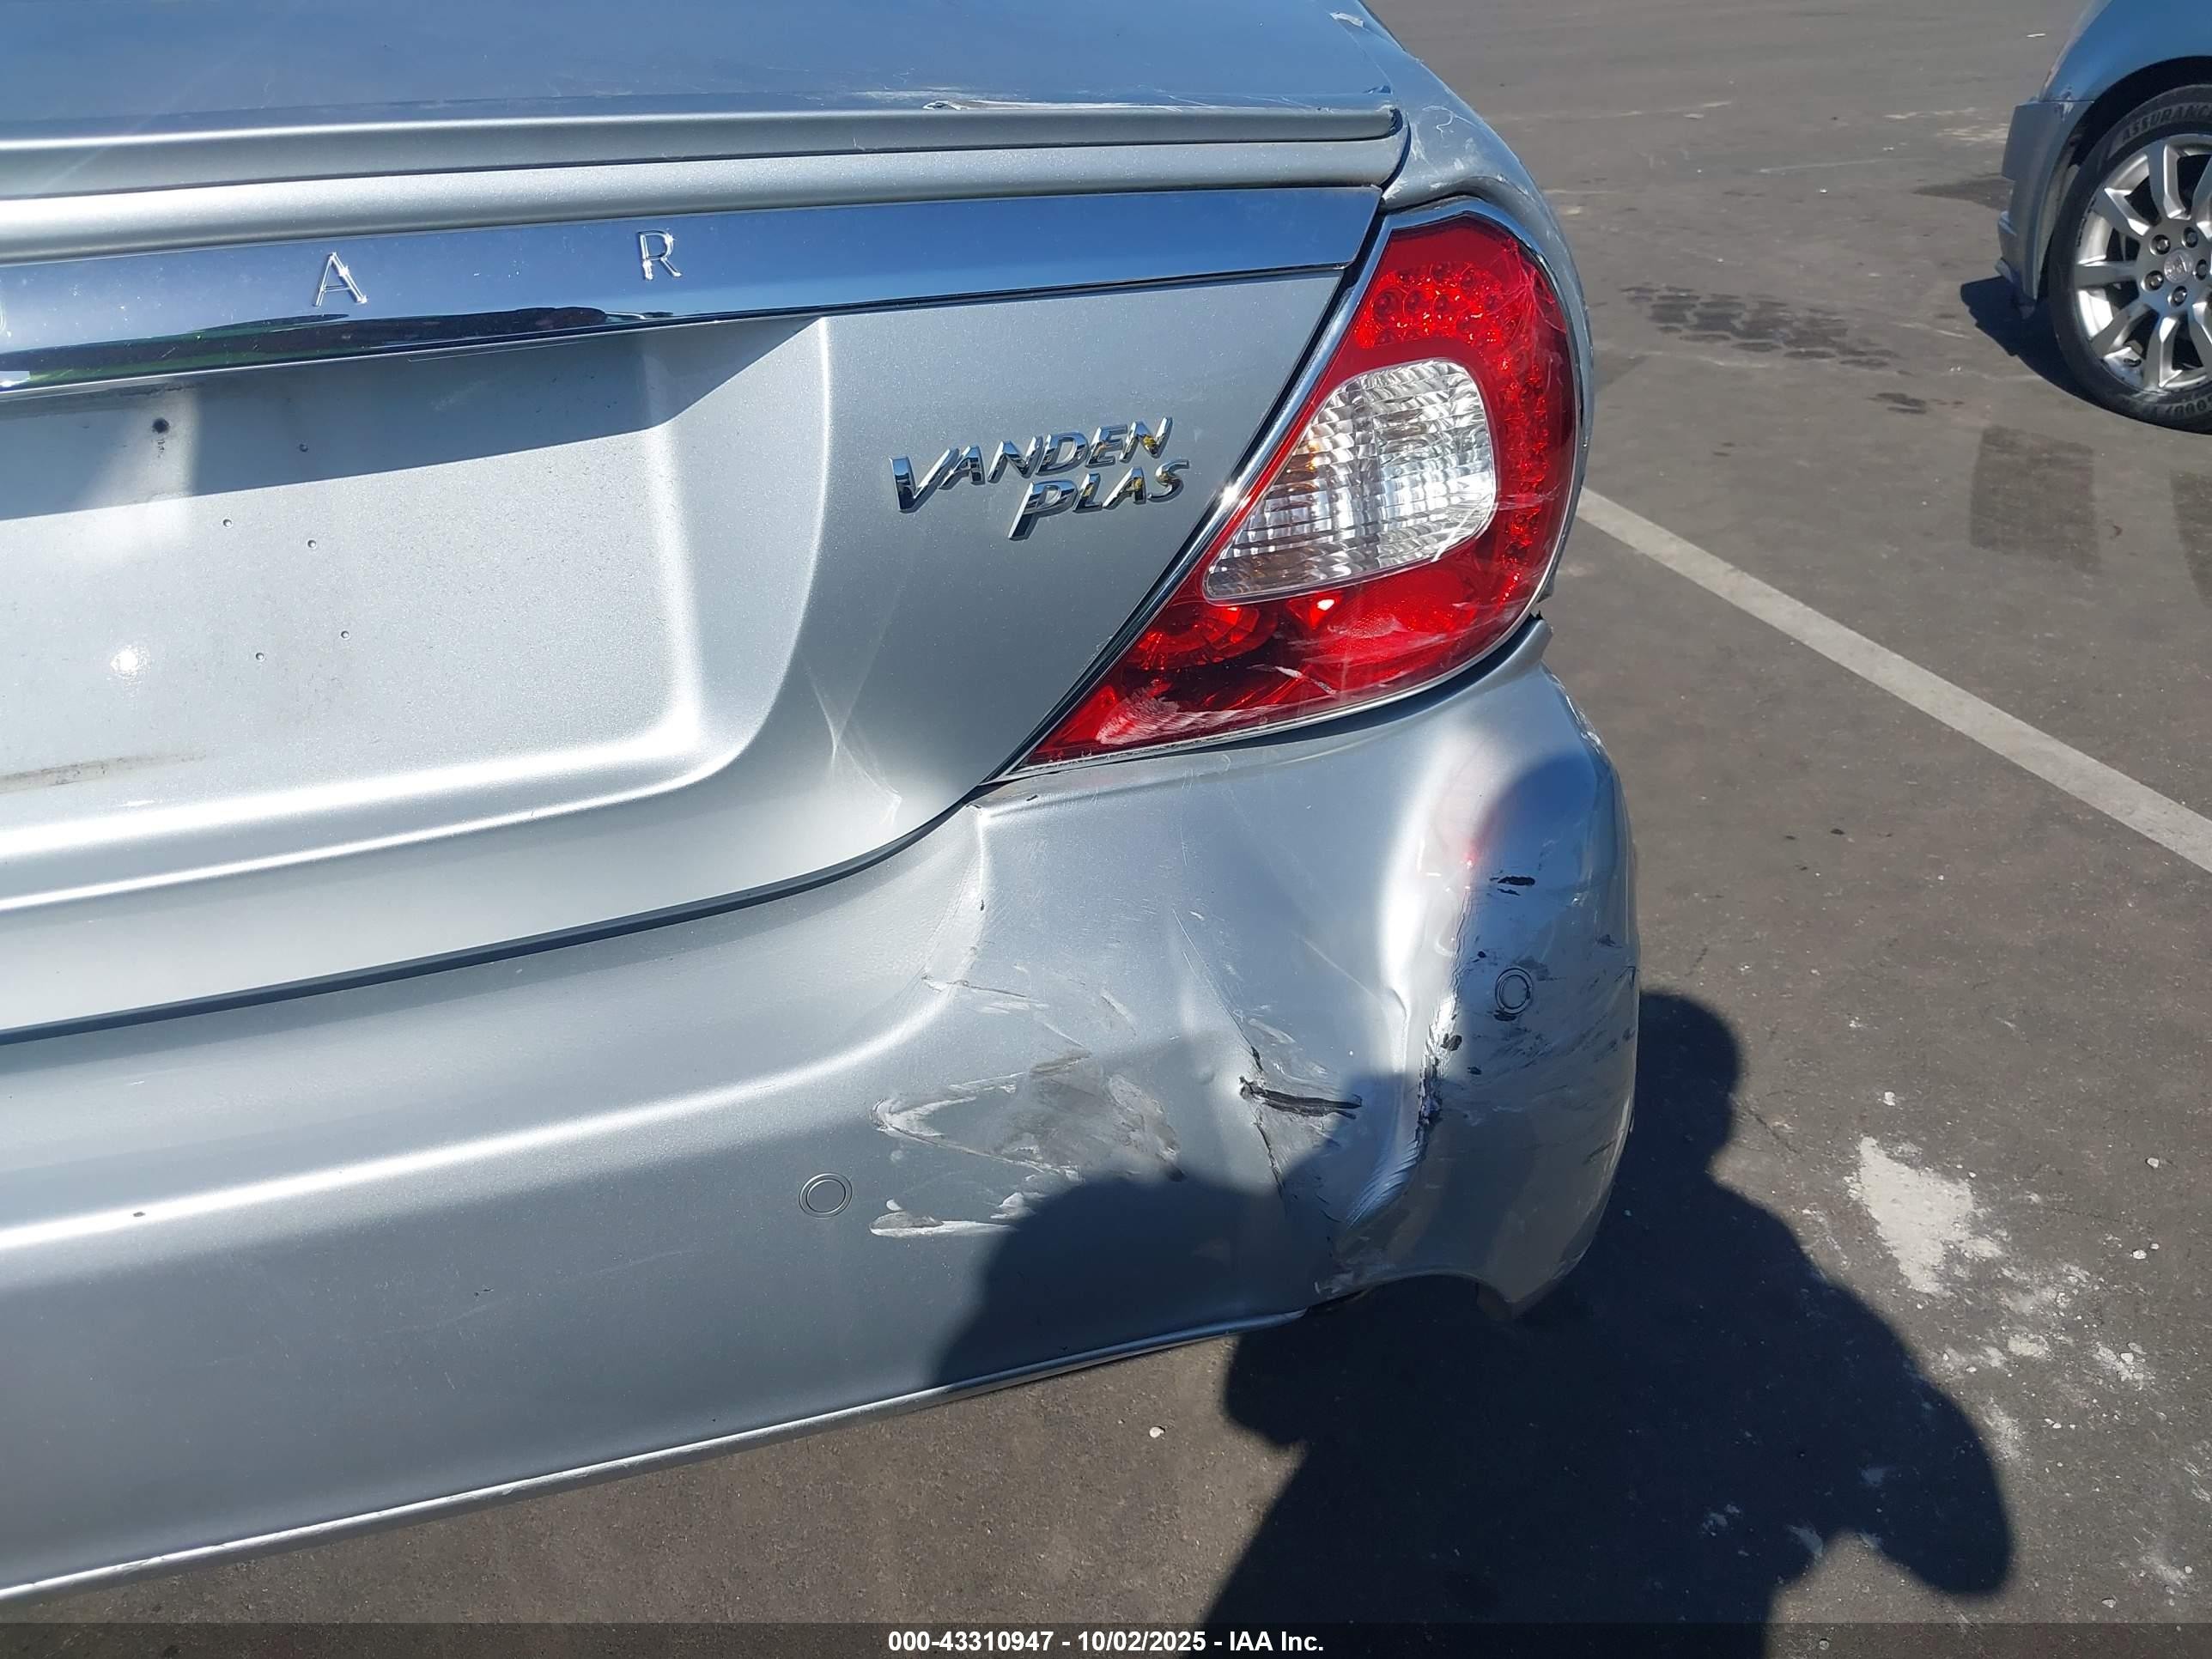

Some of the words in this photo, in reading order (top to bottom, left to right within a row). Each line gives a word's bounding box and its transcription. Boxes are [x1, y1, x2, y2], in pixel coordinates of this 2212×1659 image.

[2122, 105, 2212, 142] ASSURANC
[890, 416, 1173, 514] VANDEN
[1008, 459, 1190, 541] PLAS
